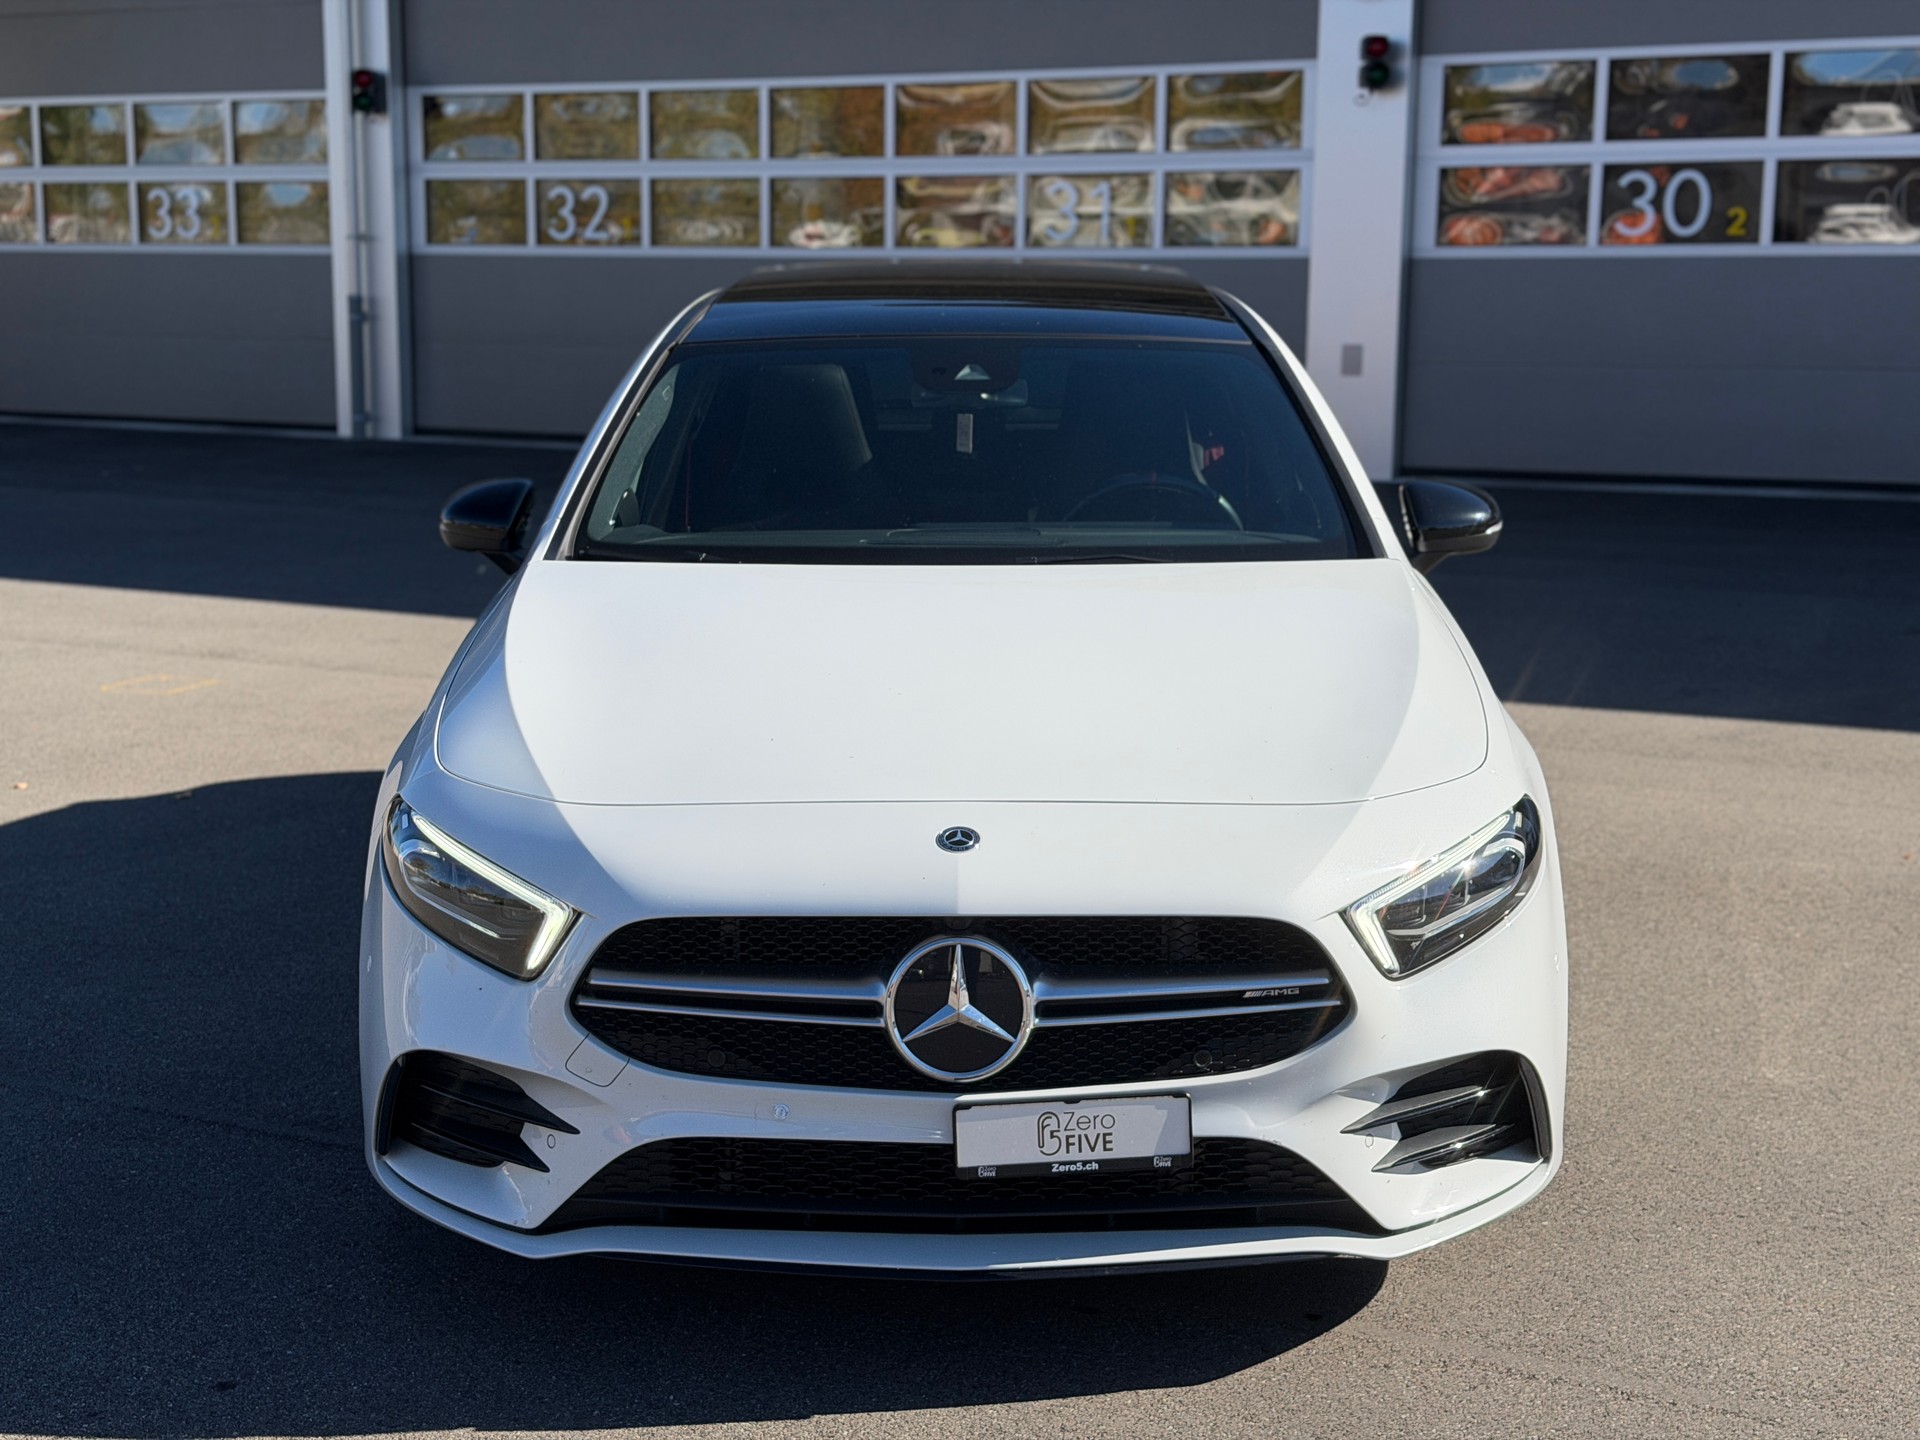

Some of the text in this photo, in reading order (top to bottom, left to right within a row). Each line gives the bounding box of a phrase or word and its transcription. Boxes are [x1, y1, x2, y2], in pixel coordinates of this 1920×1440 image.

[147, 187, 201, 239] 33
[547, 185, 610, 241] 32
[1044, 180, 1111, 244] 31
[1614, 168, 1713, 238] 30
[1725, 206, 1748, 237] 2
[1259, 987, 1300, 998] AMG
[1063, 1111, 1116, 1131] Zero
[1065, 1132, 1114, 1154] FIVE
[1051, 1161, 1099, 1172] Zero5.ch
